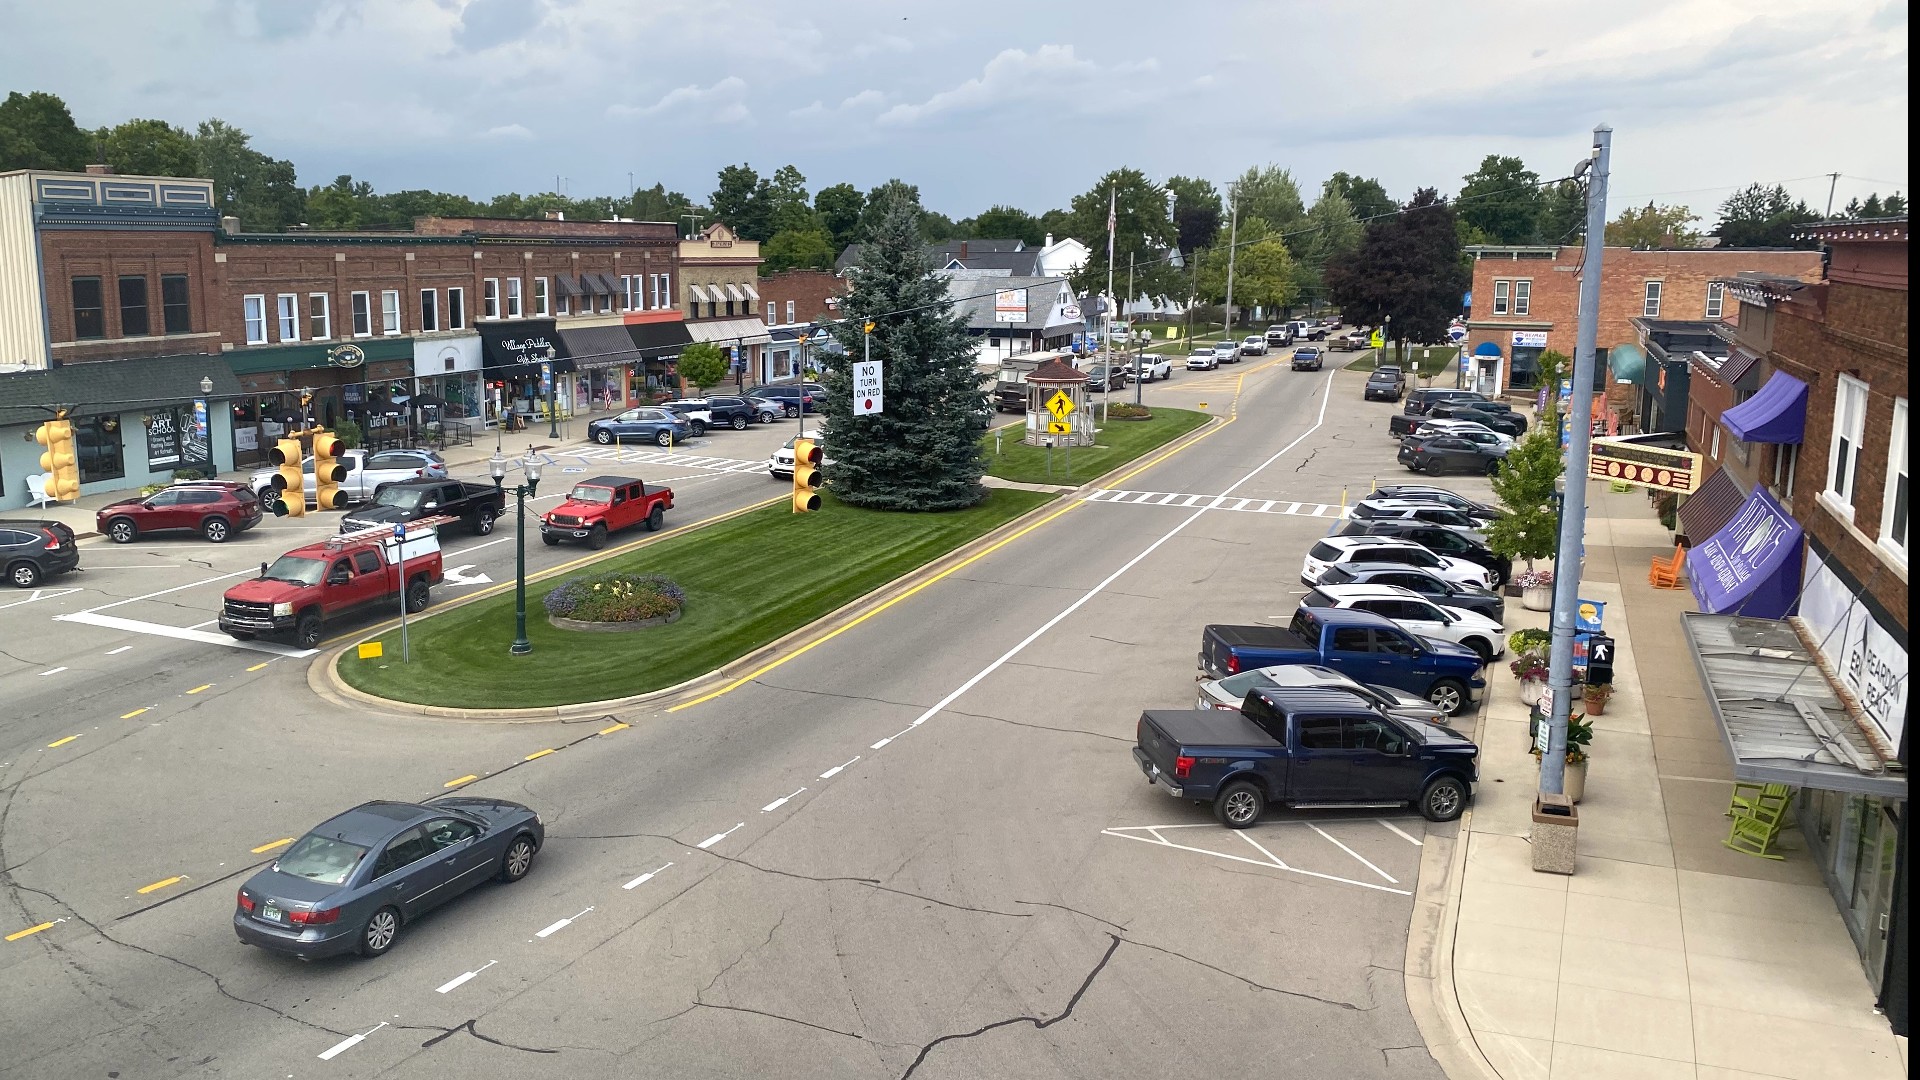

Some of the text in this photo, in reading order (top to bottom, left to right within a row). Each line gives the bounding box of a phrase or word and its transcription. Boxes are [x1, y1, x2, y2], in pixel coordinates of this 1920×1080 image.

[862, 366, 875, 377] NO
[860, 377, 877, 387] TURN
[856, 387, 880, 398] ON RED
[151, 418, 172, 430] ART
[370, 416, 388, 428] LIGHT
[148, 426, 176, 436] SCHOOL
[396, 525, 402, 533] P
[1866, 648, 1902, 705] REARDON
